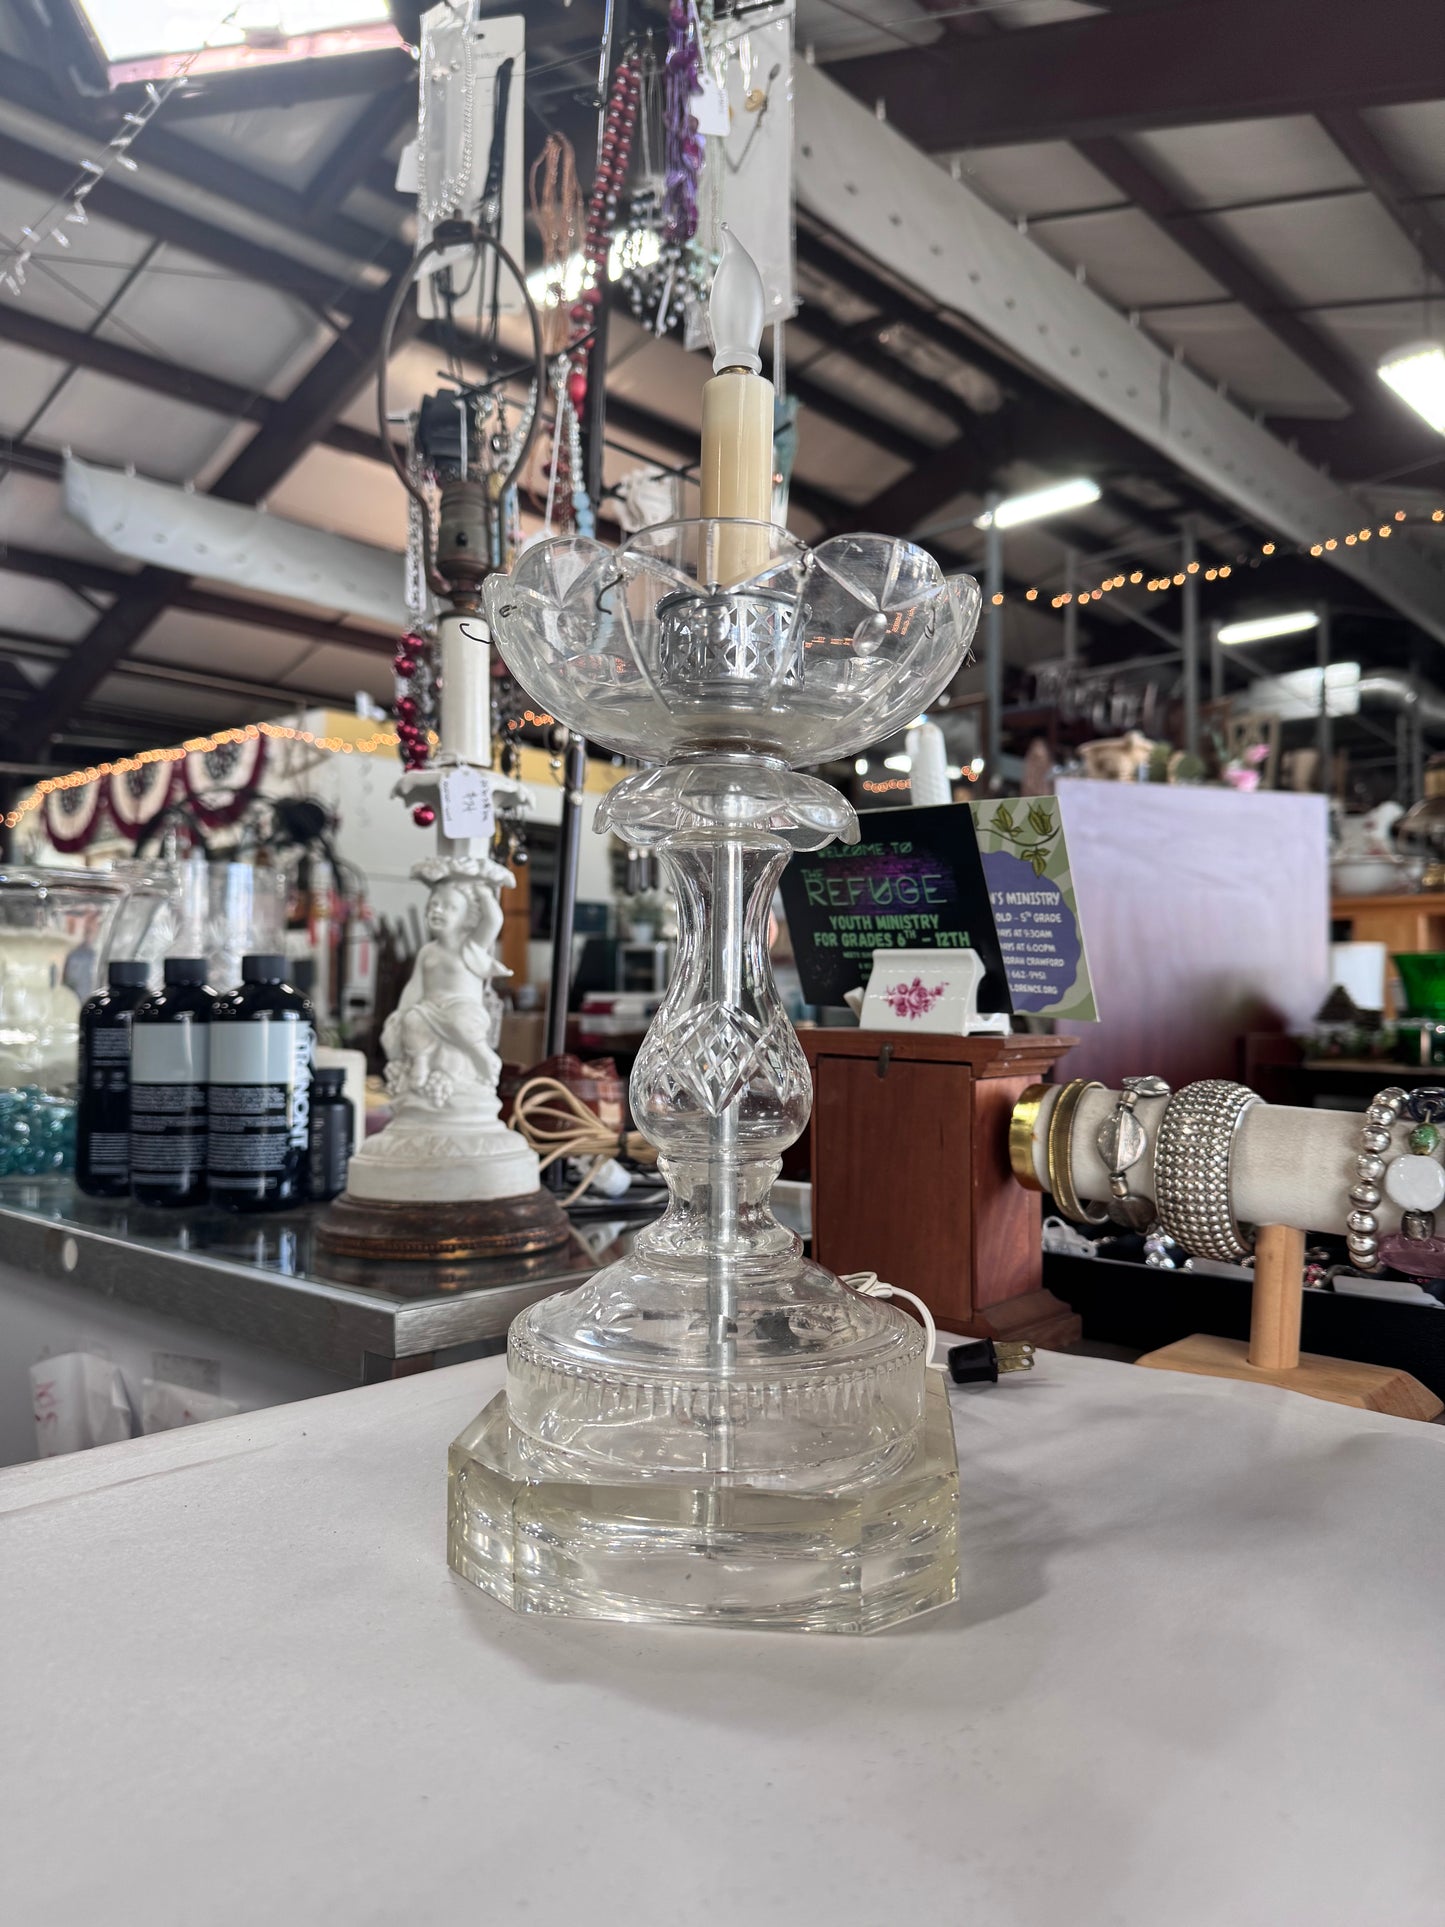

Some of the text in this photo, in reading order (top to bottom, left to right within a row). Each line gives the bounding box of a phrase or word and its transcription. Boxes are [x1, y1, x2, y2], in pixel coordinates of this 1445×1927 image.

[890, 841, 912, 853] TO
[800, 868, 825, 879] THE
[805, 874, 948, 906] REFUGE
[1005, 892, 1060, 906] MINISTRY
[829, 914, 940, 930] YOUTH MINISTRY
[995, 912, 1012, 922] OLD
[1033, 913, 1062, 923] GRADE
[814, 932, 839, 947] FOR
[841, 932, 893, 947] GRADES
[935, 931, 971, 947] 12TH
[1013, 929, 1022, 938] AT
[1016, 943, 1025, 951] AT
[1026, 957, 1065, 967] CRAWFORD
